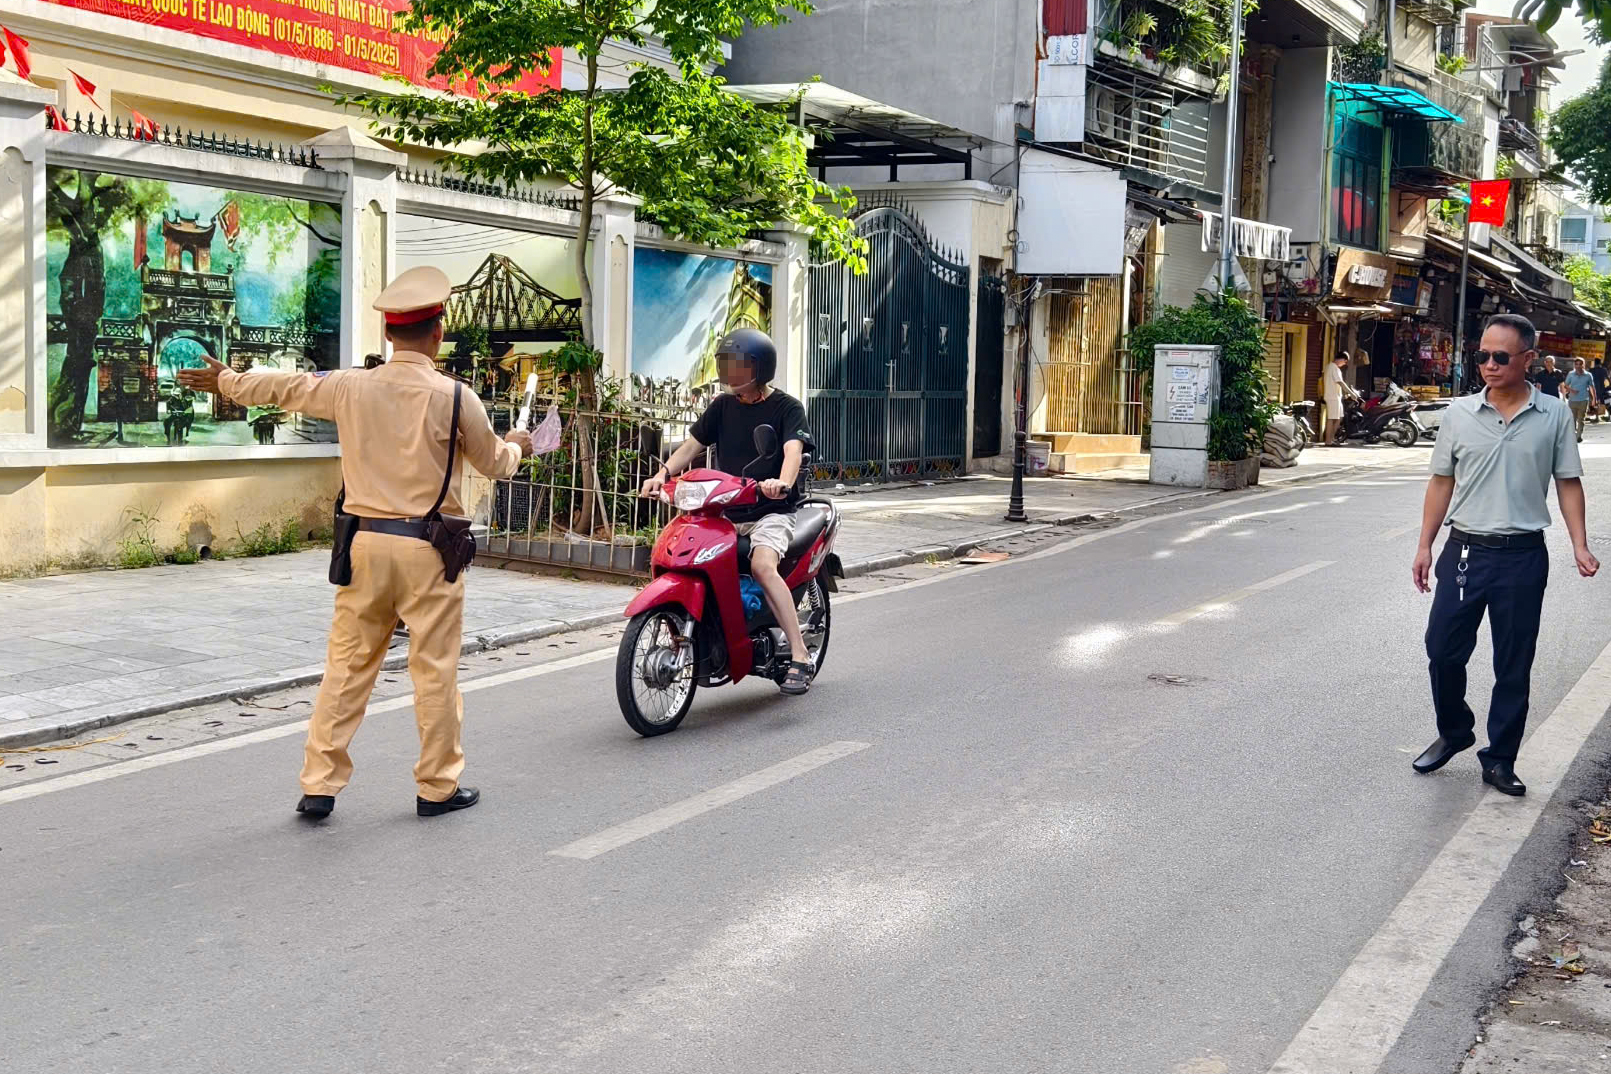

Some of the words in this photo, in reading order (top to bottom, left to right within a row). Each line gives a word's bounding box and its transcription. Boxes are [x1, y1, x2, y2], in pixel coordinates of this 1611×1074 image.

[210, 0, 233, 28] LAO
[236, 4, 271, 38] ĐỘNG
[273, 15, 334, 52] (01/5/1886
[344, 33, 400, 69] 01/5/2025)
[368, 2, 389, 30] ĐẤT
